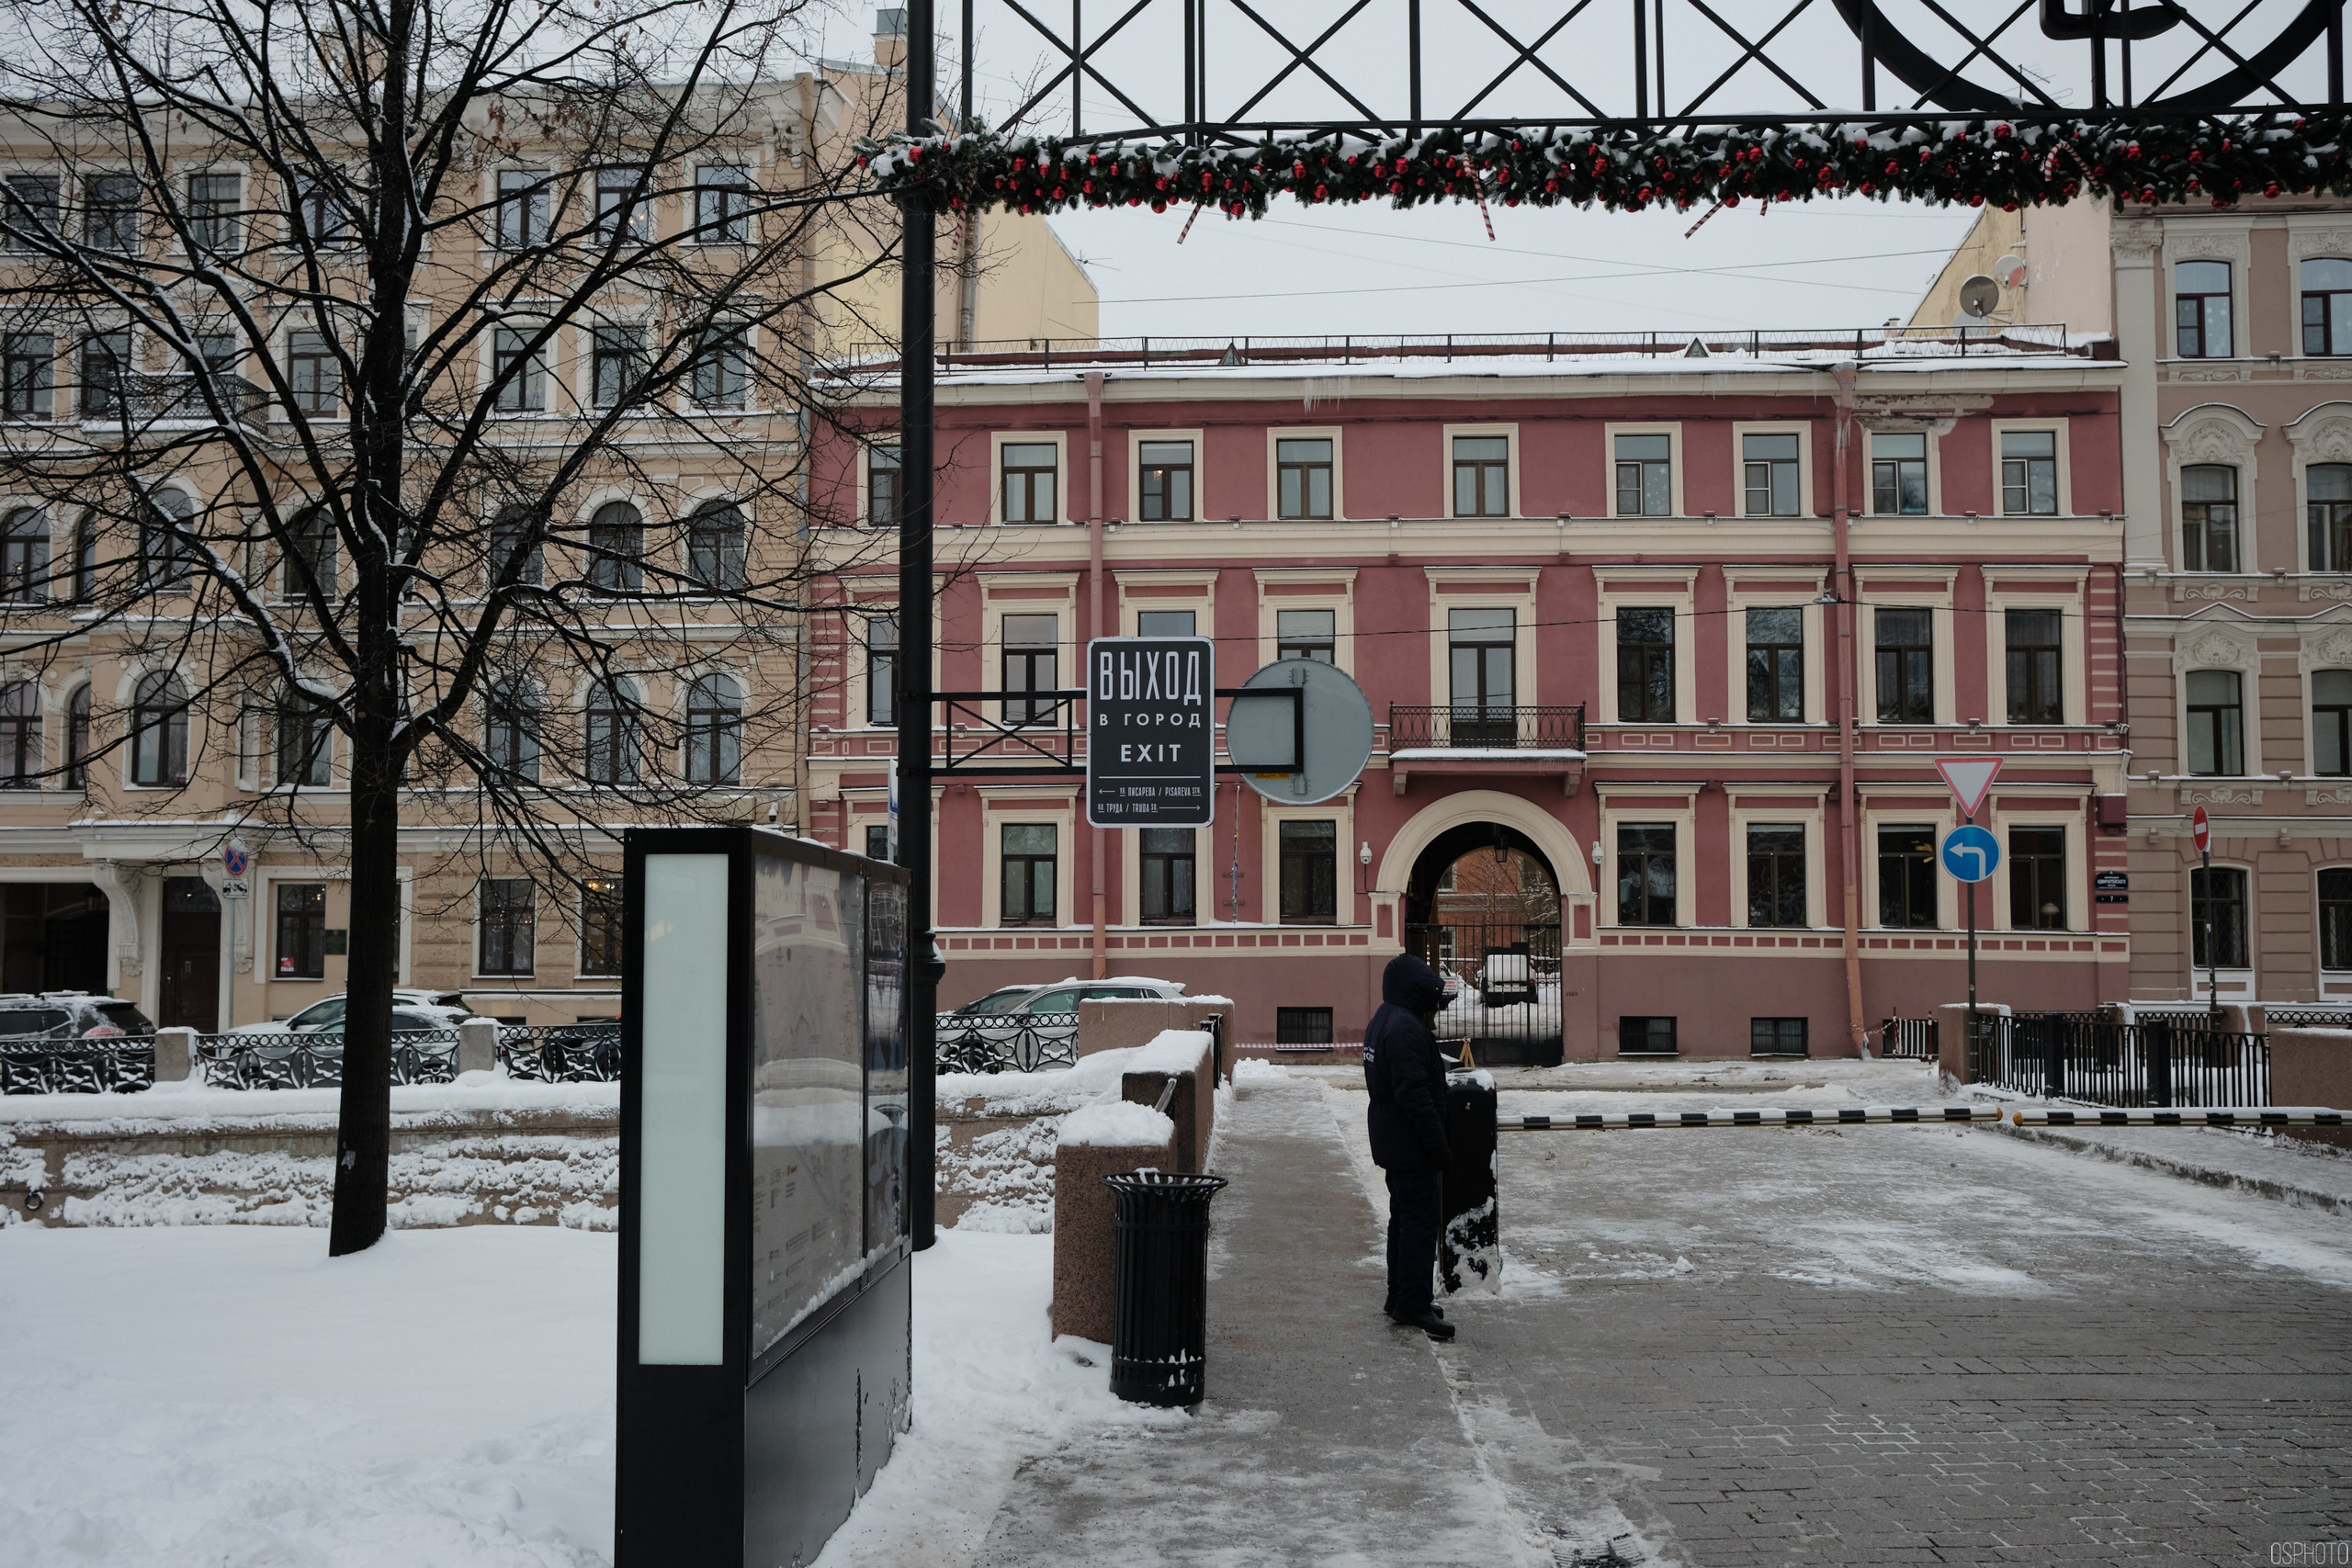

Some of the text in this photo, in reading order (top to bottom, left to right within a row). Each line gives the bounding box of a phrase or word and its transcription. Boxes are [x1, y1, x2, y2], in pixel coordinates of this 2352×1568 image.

[1100, 651, 1202, 706] ВЫХОД
[1100, 714, 1201, 728] В ГОРОД
[1121, 744, 1182, 762] EXIT
[1128, 786, 1156, 796] ПИСАРЕВА
[1165, 786, 1191, 796] PISAREVA
[1106, 803, 1123, 814] ТРУДА
[1133, 803, 1149, 813] TRUDA
